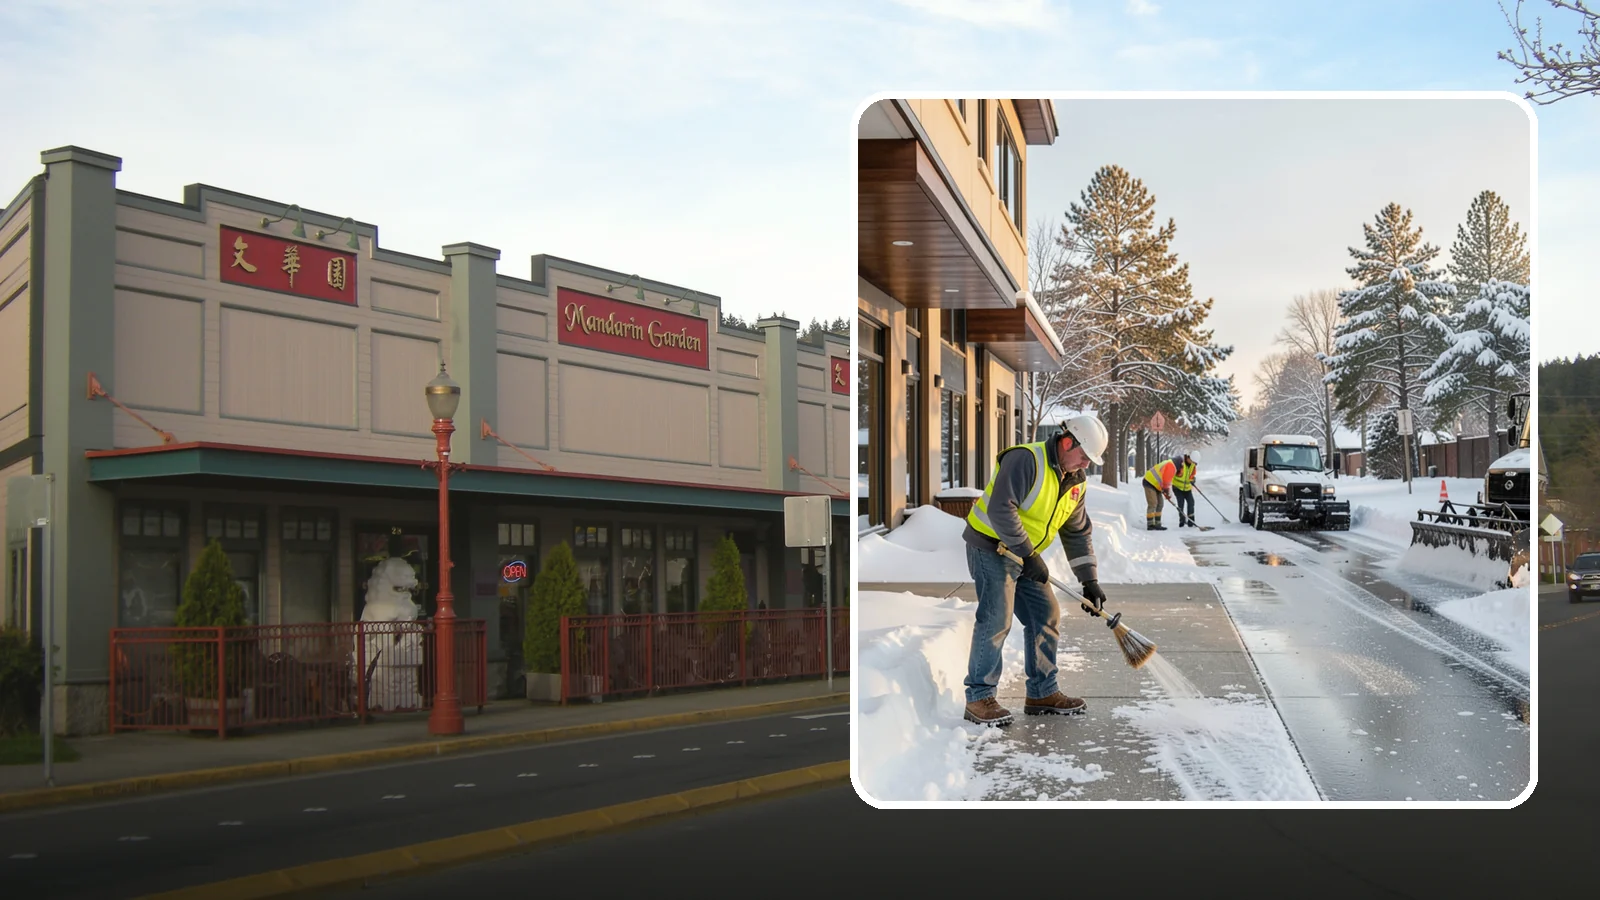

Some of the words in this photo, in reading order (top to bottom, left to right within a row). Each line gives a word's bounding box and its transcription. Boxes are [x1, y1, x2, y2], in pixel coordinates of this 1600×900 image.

[564, 302, 644, 340] Mandarin
[648, 320, 702, 352] Garden
[503, 565, 527, 578] OPEN
